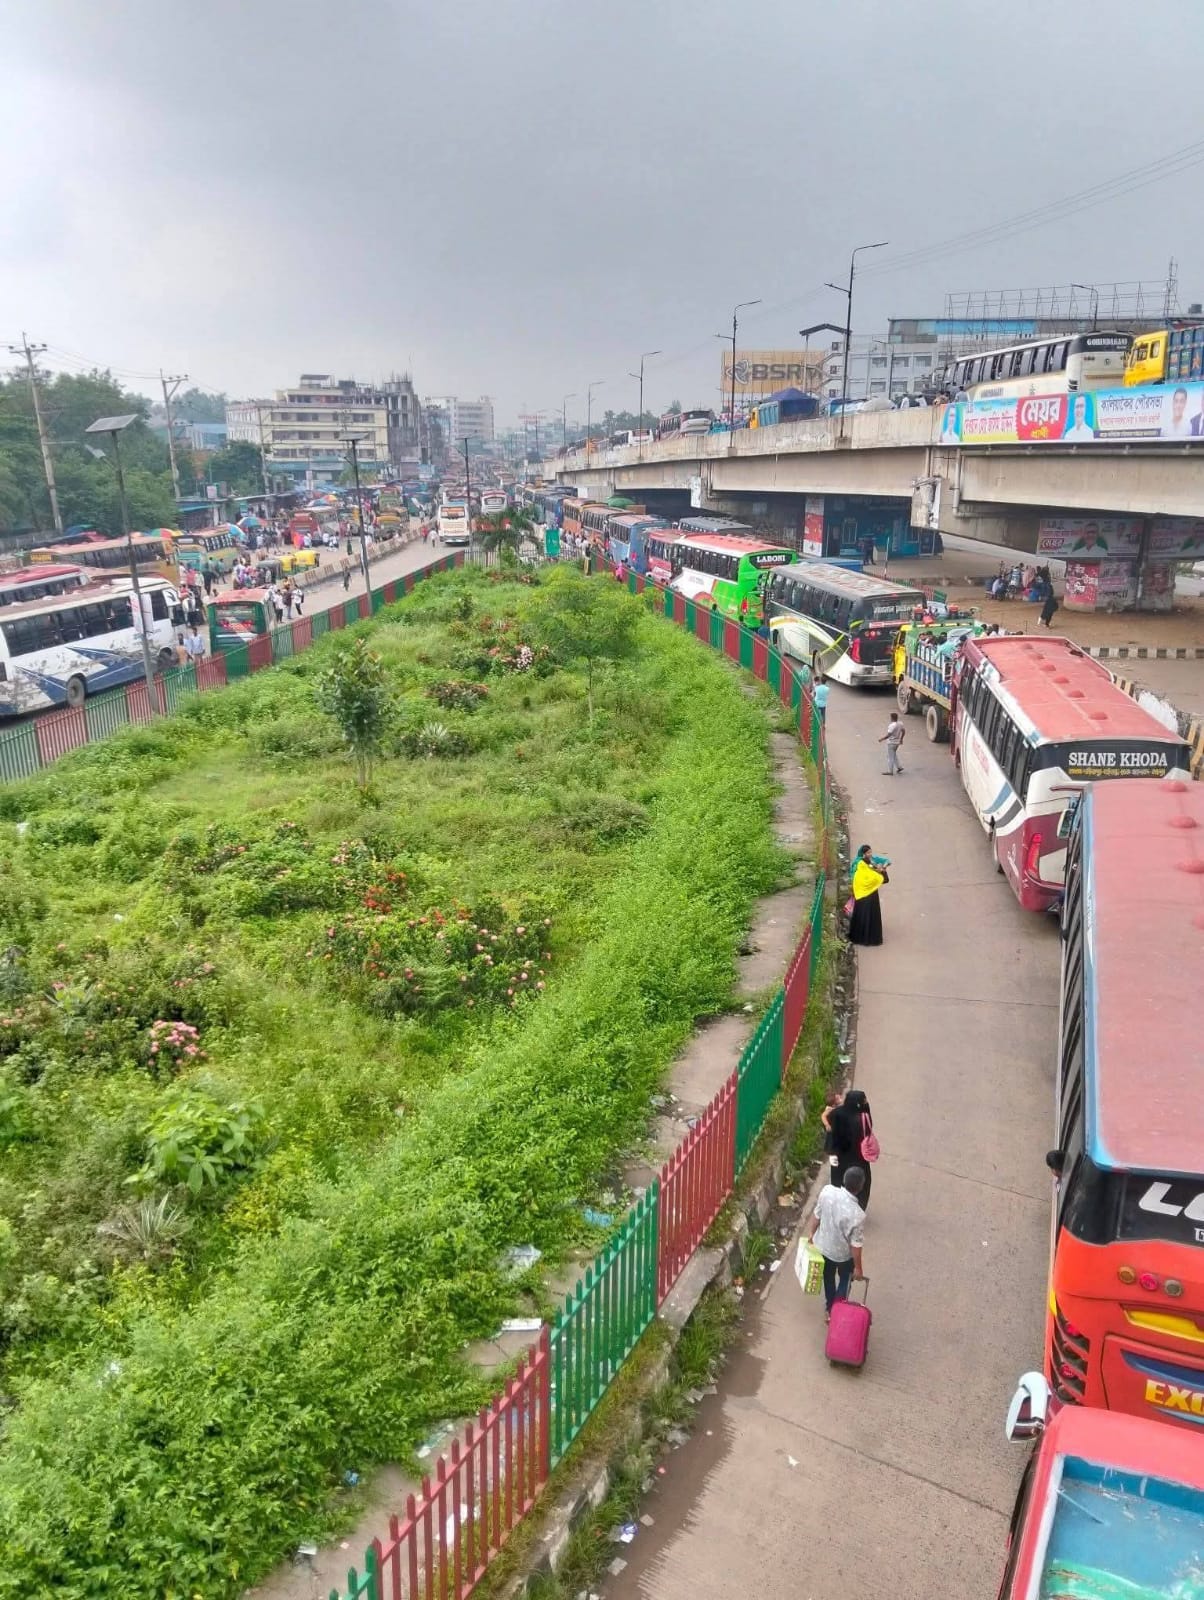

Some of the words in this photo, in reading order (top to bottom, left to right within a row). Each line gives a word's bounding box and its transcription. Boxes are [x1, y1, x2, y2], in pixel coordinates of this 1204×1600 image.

[1020, 397, 1061, 426] মেয়র
[756, 555, 786, 563] LABONI
[1068, 752, 1116, 767] SHANE
[1119, 752, 1168, 767] KHODA
